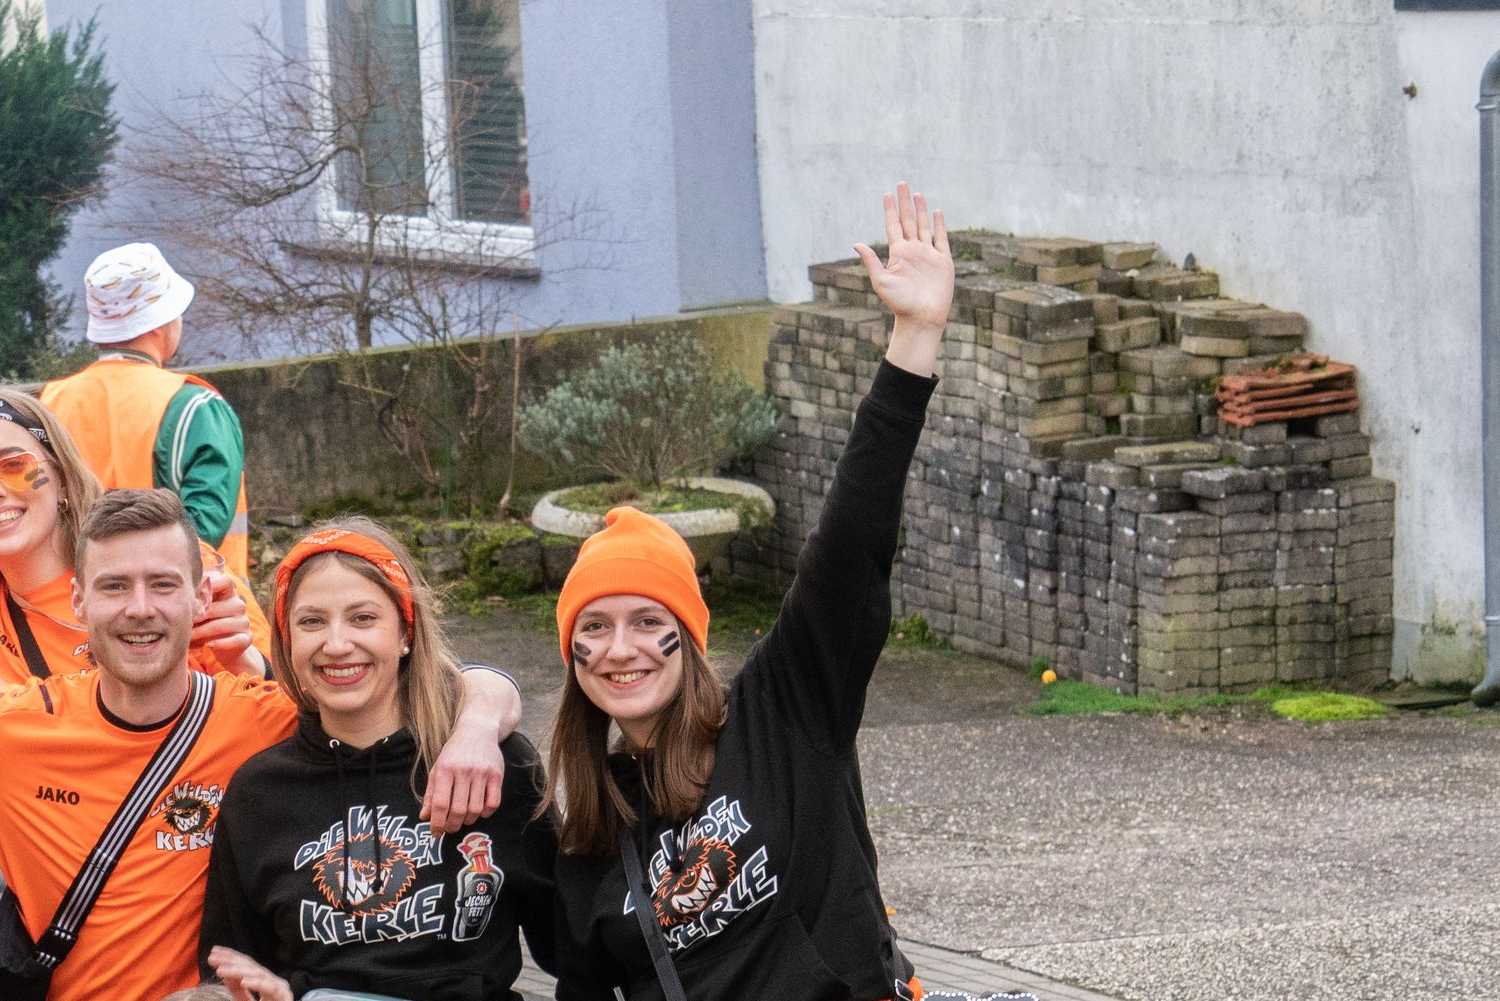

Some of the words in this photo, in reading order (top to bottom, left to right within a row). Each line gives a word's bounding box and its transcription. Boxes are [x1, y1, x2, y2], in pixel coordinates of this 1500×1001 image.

[35, 785, 80, 806] JAKO
[155, 820, 217, 852] KERL
[300, 883, 445, 945] KERLE
